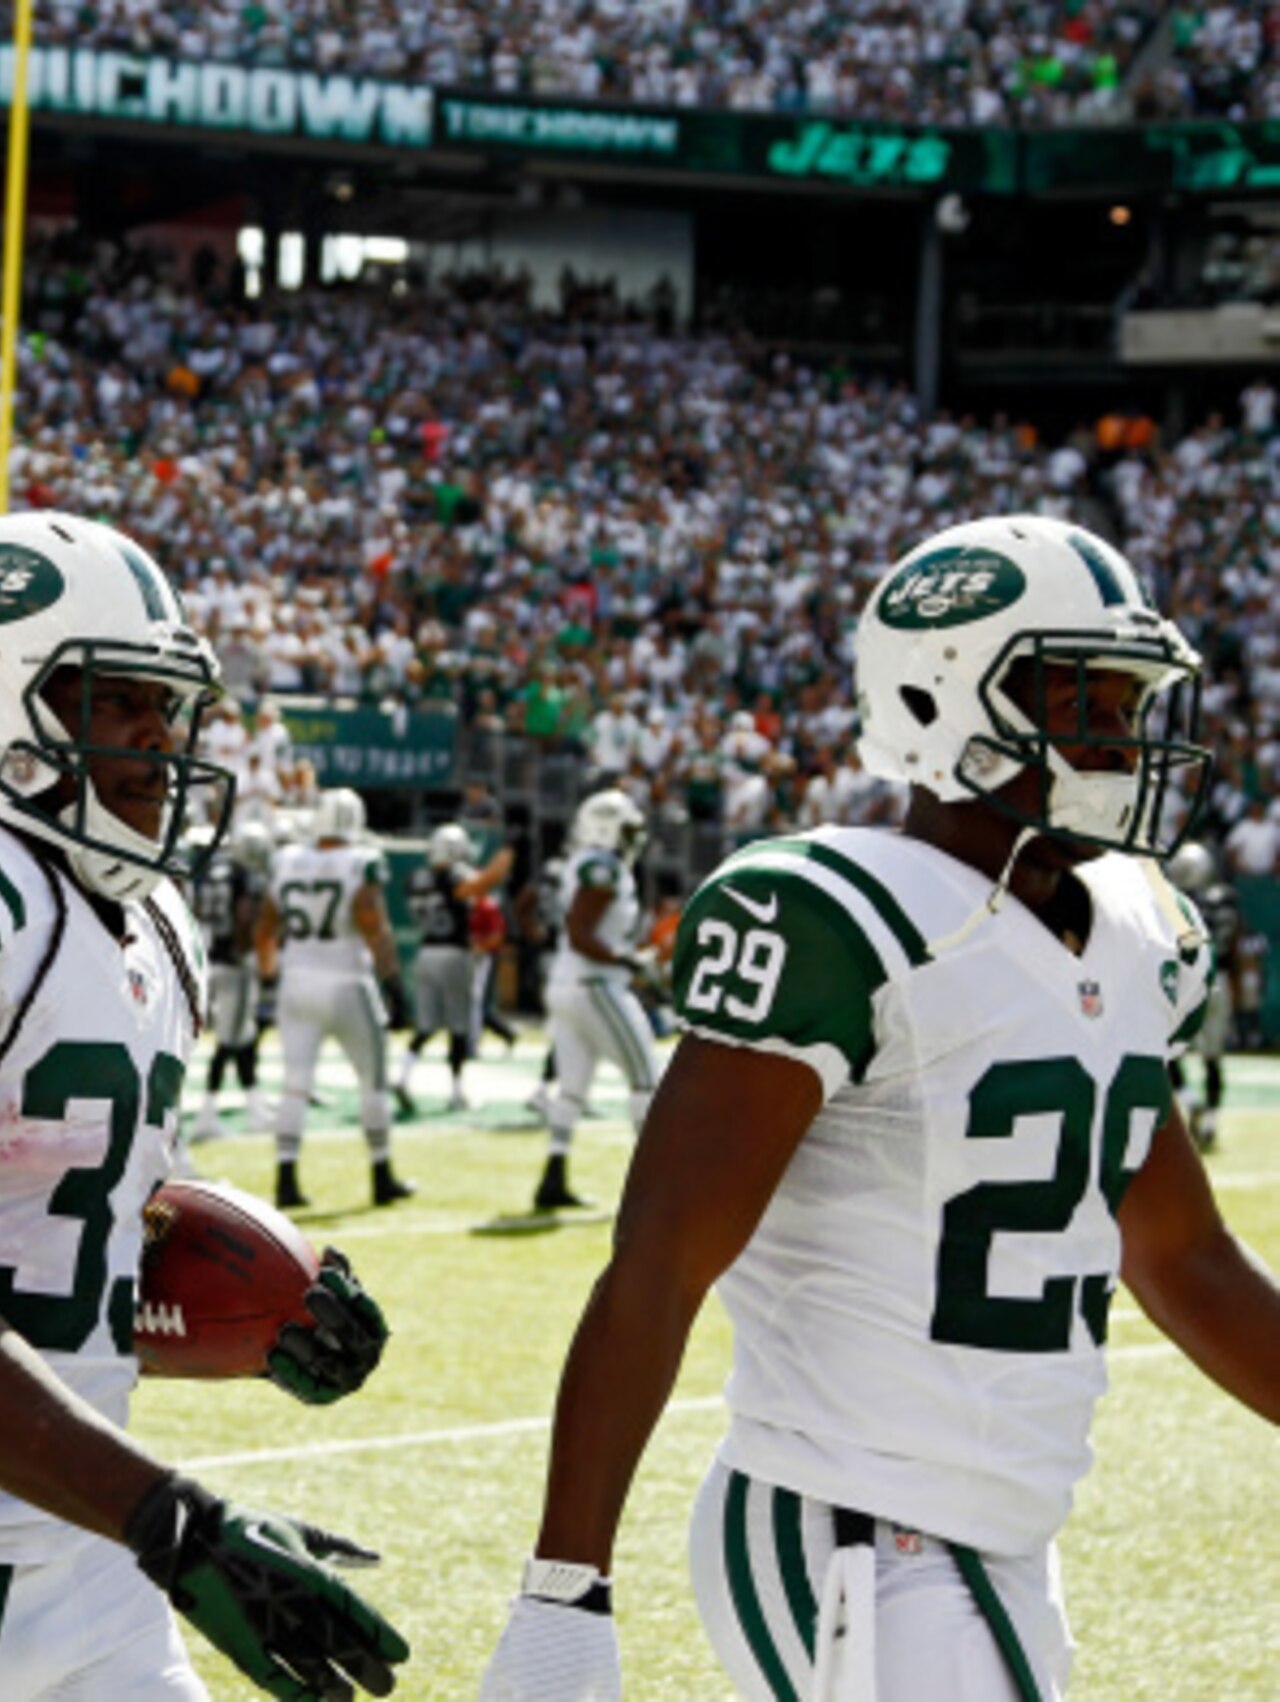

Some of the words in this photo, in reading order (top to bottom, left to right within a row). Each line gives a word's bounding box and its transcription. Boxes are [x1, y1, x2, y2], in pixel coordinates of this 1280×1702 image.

[442, 99, 677, 153] TOUCHDOWN
[768, 121, 951, 182] JETS
[887, 570, 997, 605] JETS
[280, 879, 343, 940] 67
[686, 918, 788, 1024] 29
